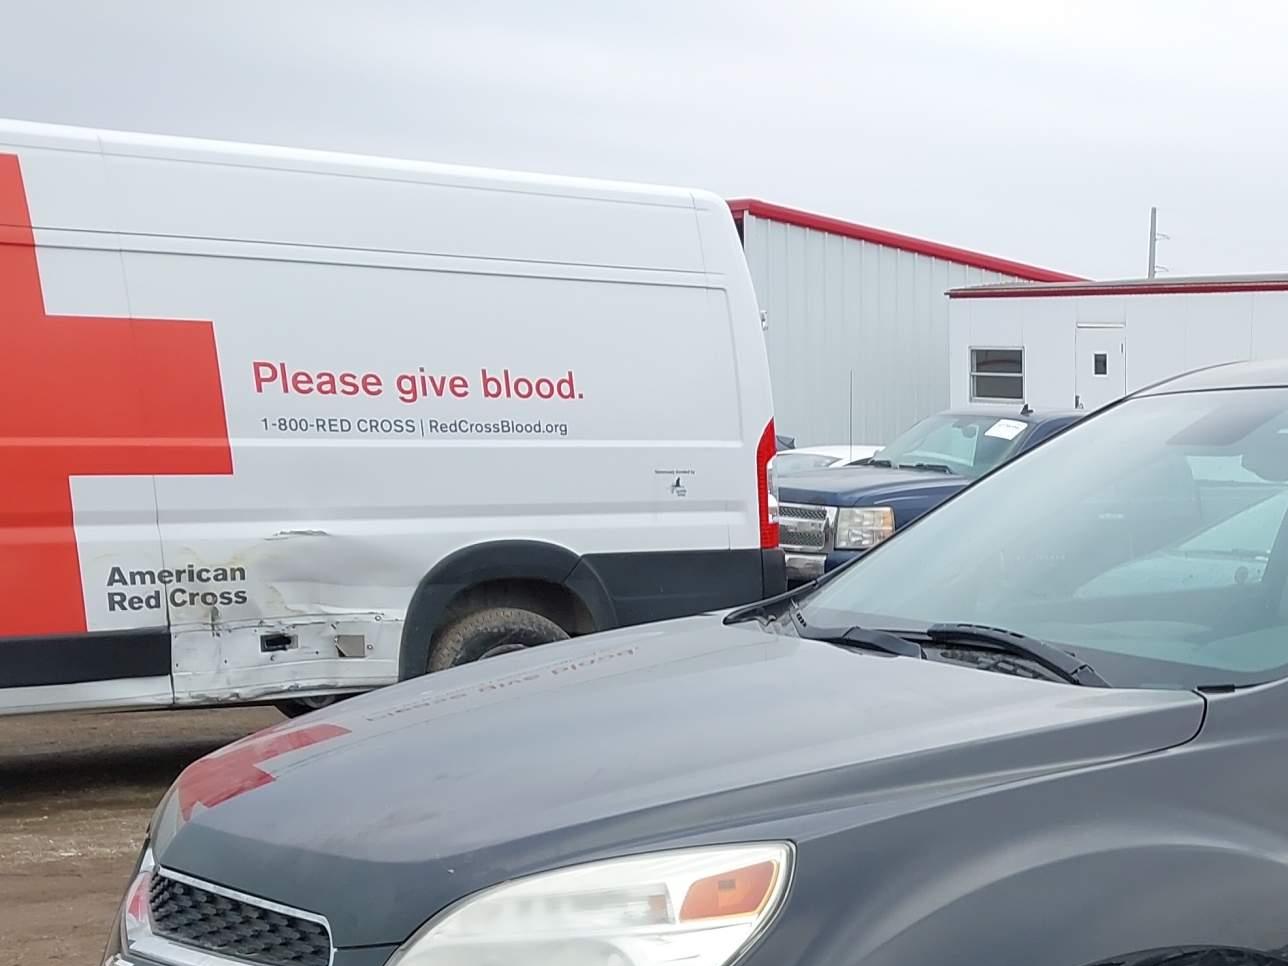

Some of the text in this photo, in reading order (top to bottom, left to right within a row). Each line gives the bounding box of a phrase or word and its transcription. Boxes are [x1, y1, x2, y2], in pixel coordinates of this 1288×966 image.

[252, 361, 585, 403] Please give blood.
[260, 417, 352, 433] 1-800-RED
[356, 418, 416, 434] CROSS
[428, 419, 568, 436] RedCrossBlood.org
[106, 564, 247, 587] American
[107, 587, 248, 612] Red Cross
